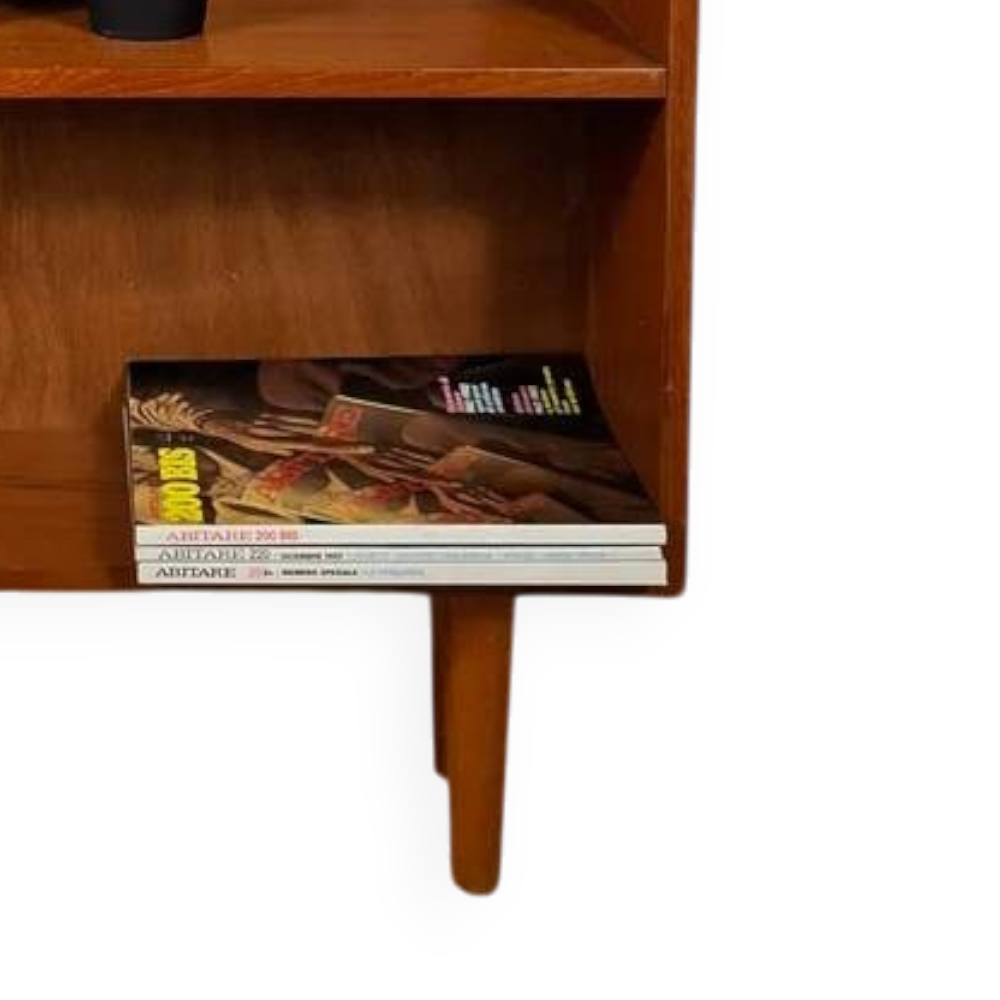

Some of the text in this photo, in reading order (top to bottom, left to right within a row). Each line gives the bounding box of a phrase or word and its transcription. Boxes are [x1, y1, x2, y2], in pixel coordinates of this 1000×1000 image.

[158, 446, 198, 481] BIS
[159, 482, 204, 523] 200
[166, 529, 252, 542] ABITARE
[158, 548, 245, 561] ABITARE
[156, 567, 236, 579] ABITARE
